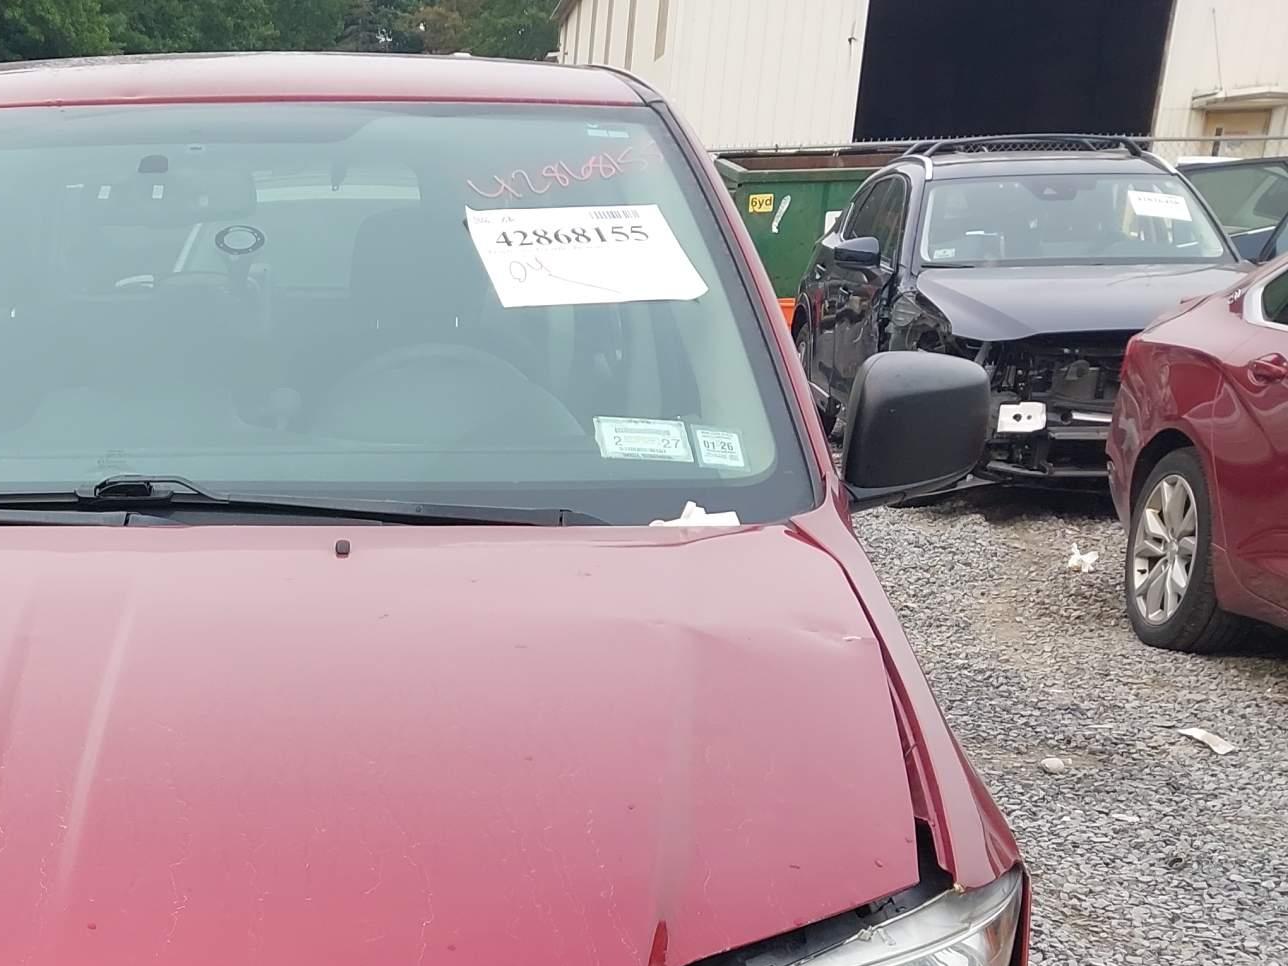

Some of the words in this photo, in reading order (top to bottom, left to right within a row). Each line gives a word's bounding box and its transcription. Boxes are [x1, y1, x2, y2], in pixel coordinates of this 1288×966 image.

[750, 196, 773, 211] 6yd
[496, 226, 649, 247] 42868155
[661, 438, 681, 449] 27
[720, 441, 734, 451] 26
